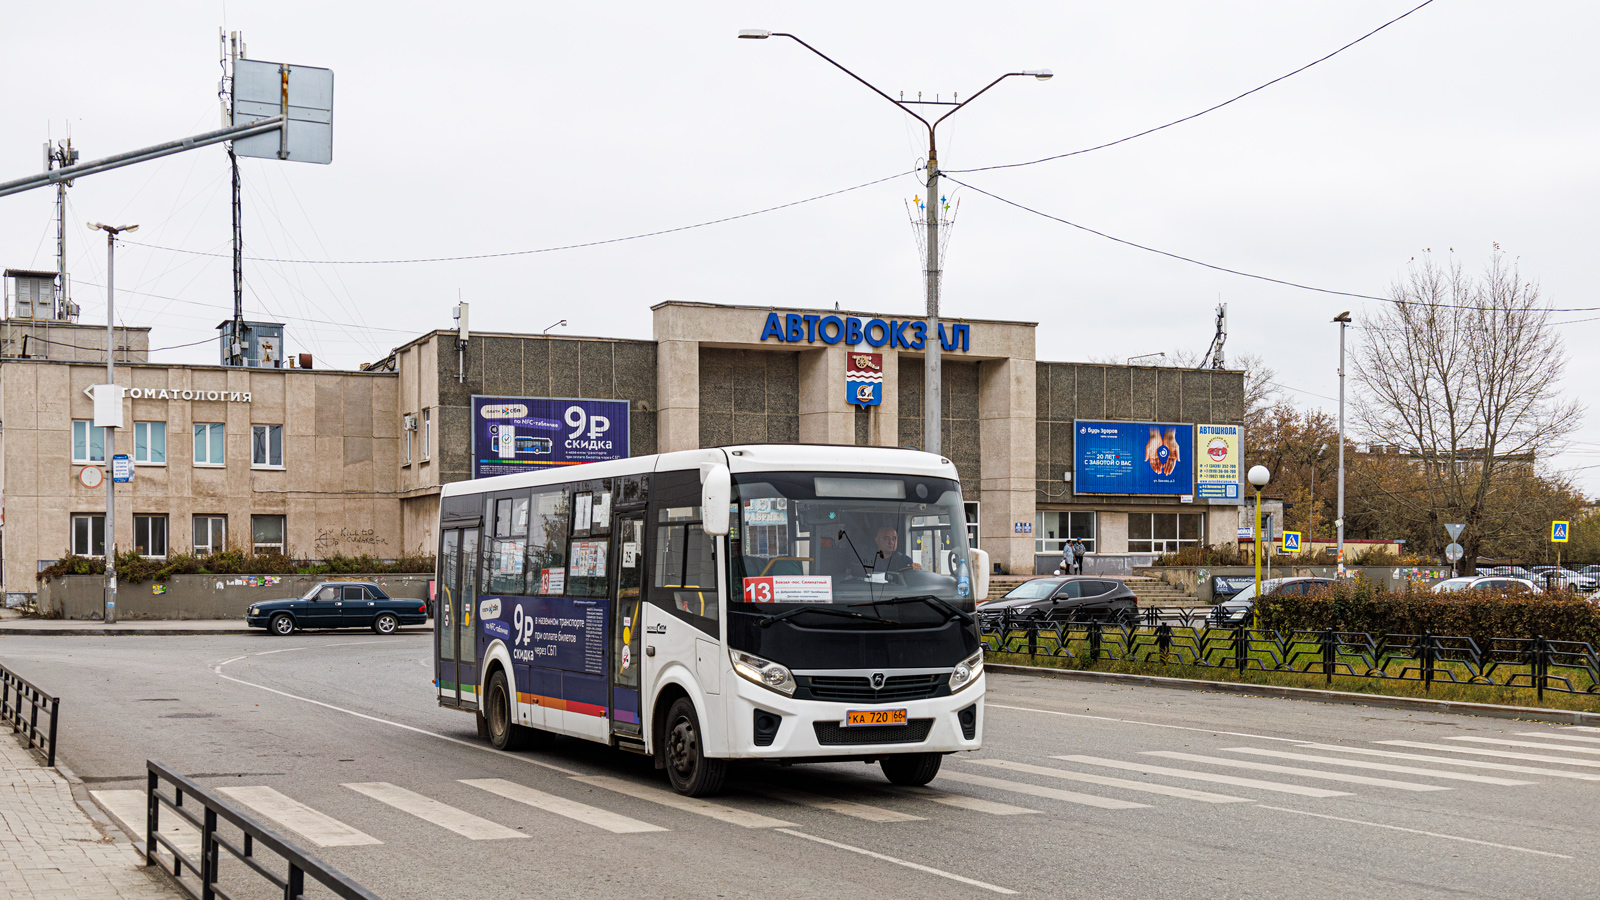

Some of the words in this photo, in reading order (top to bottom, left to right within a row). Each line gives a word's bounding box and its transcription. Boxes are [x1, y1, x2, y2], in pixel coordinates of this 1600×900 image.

[121, 387, 252, 402] ТОМАТОЛОГИЯ
[1199, 426, 1237, 435] АВТОШКОЛА
[564, 439, 613, 451] скидка
[745, 582, 772, 602] 13
[559, 618, 585, 630] транспорте
[534, 631, 543, 642] при
[543, 632, 558, 641] оплате
[557, 630, 577, 643] билетов
[513, 648, 534, 662] скидка
[534, 646, 547, 657] через
[546, 644, 558, 656] СБП
[852, 714, 866, 723] КА
[869, 711, 889, 723] 720
[893, 710, 903, 719] 66
